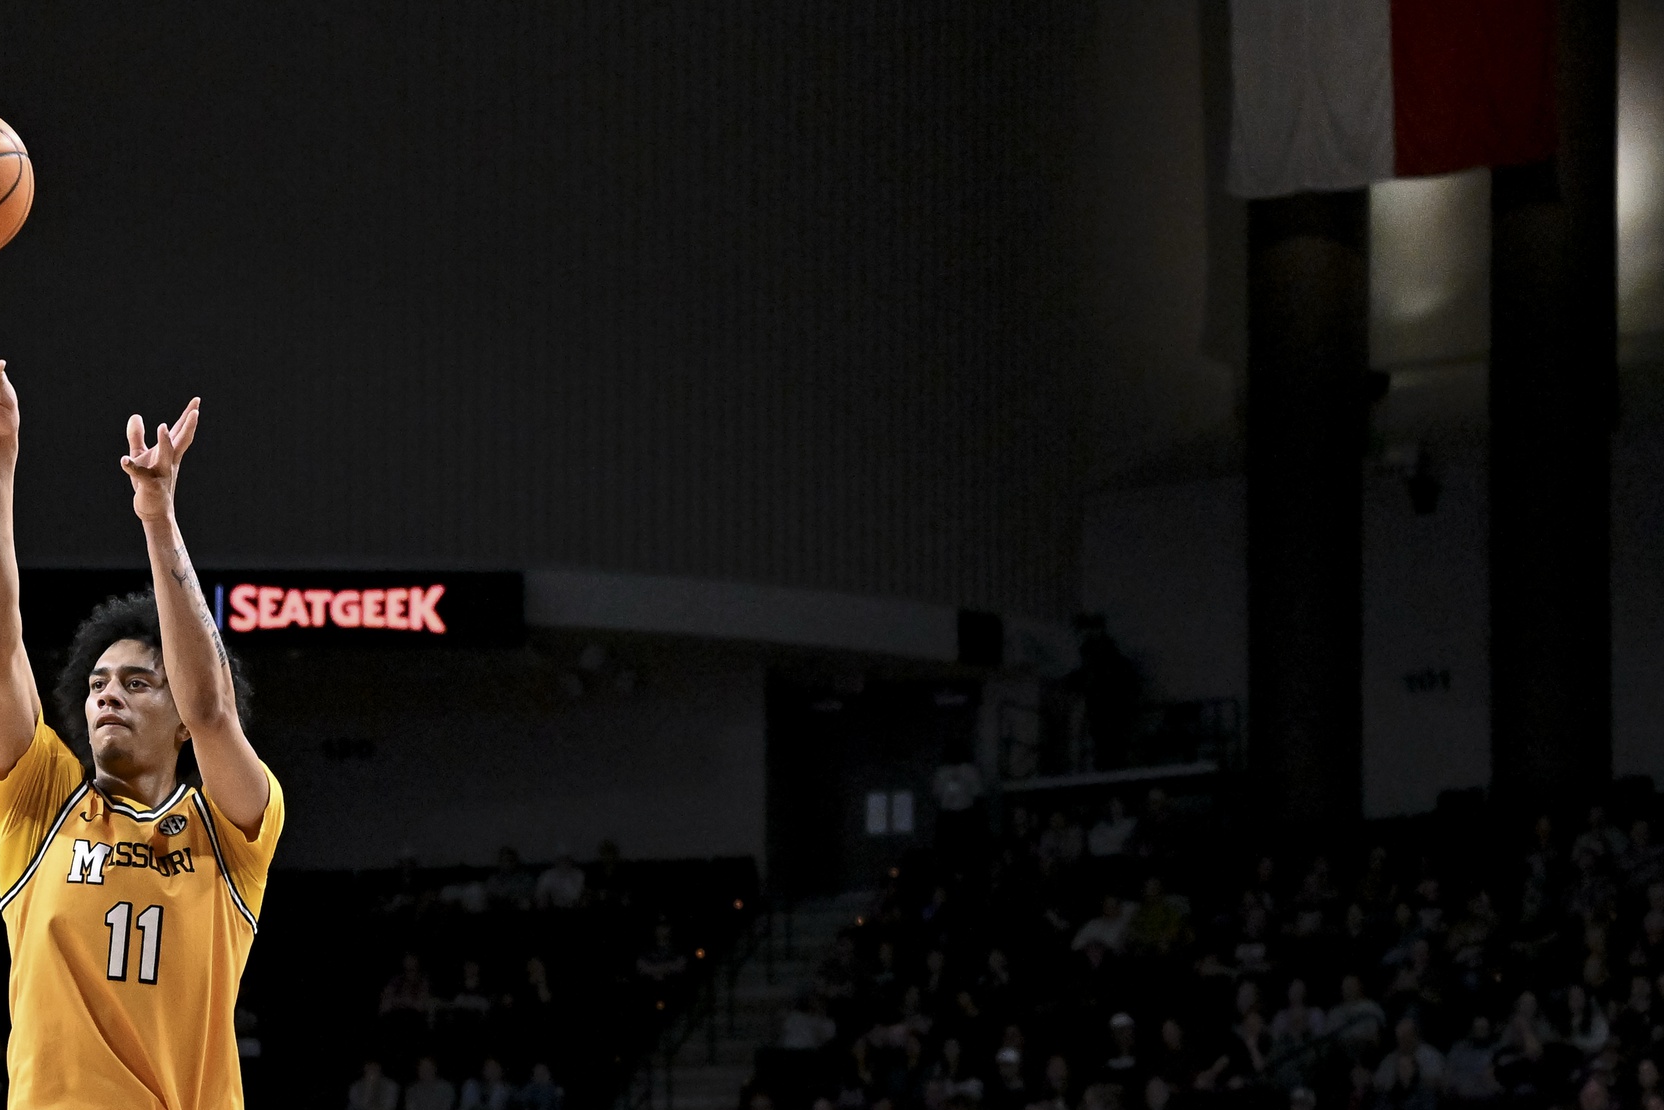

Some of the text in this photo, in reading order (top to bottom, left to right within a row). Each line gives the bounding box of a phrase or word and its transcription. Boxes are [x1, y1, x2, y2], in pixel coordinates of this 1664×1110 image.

[228, 584, 446, 634] SEATGEEK
[160, 816, 186, 836] SEC
[104, 901, 164, 985] 11
